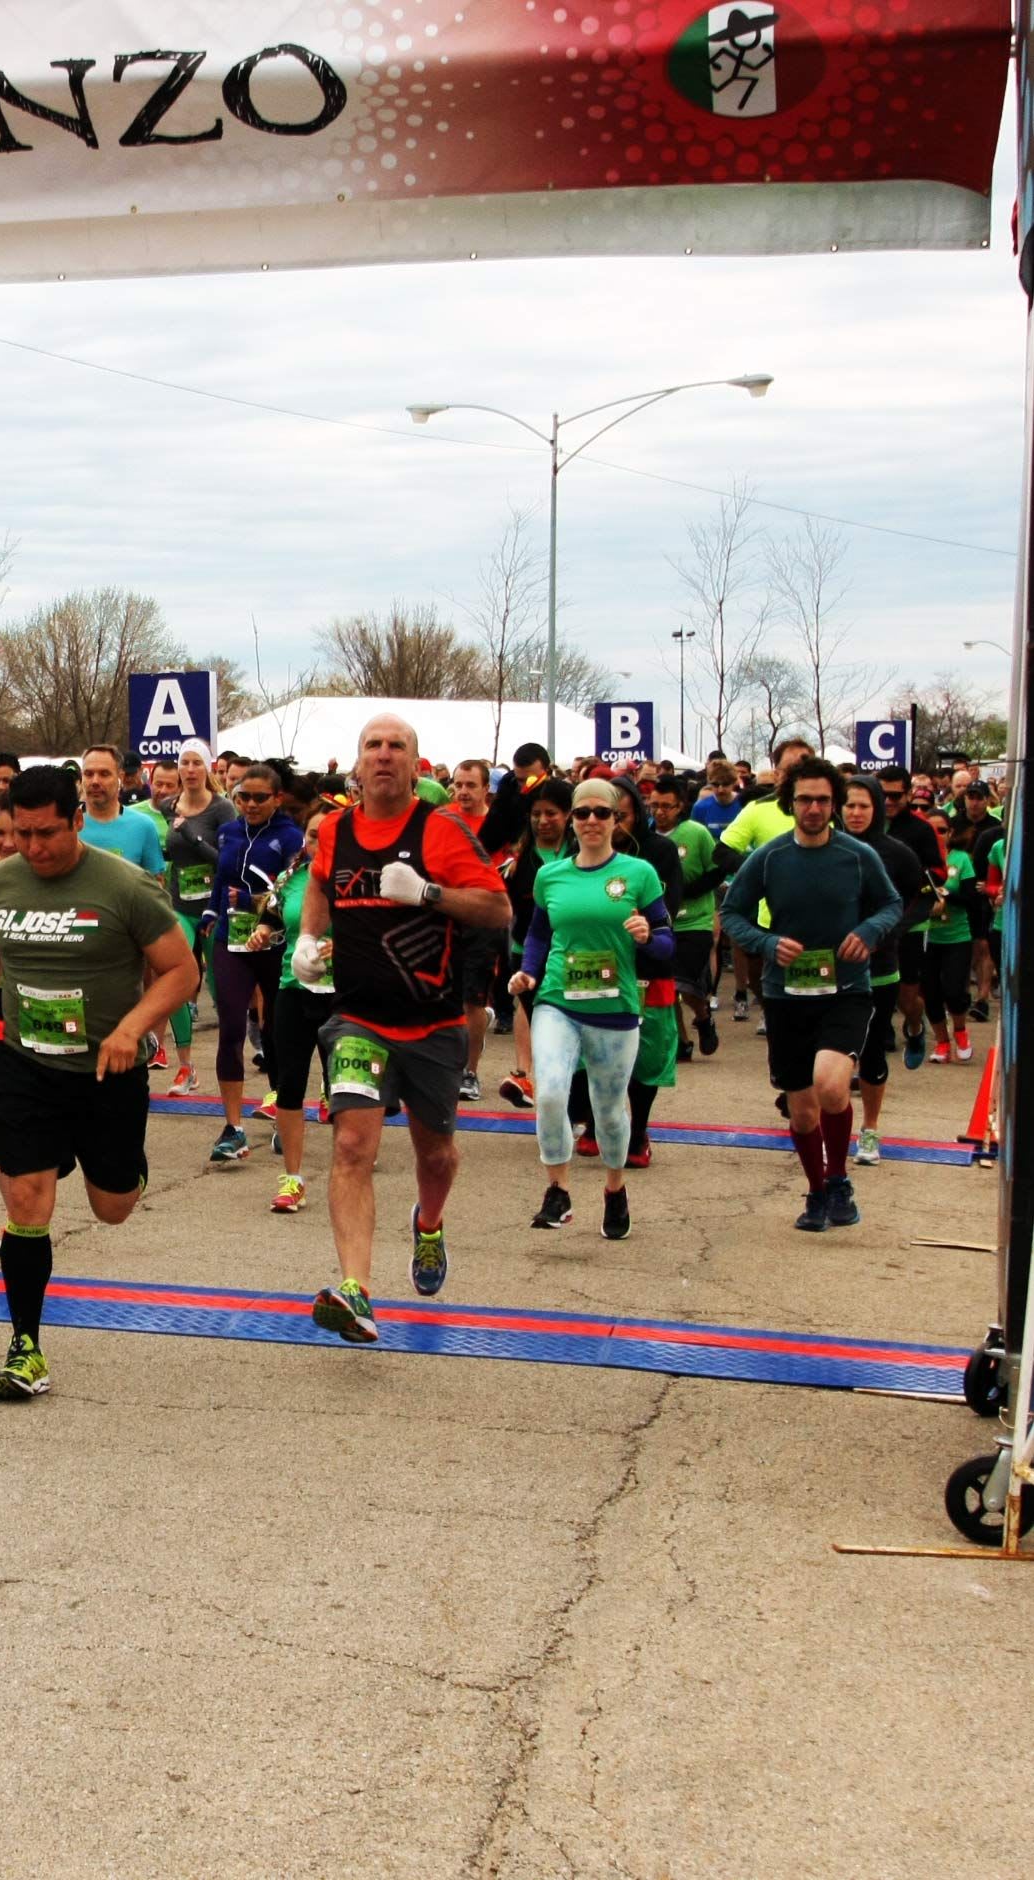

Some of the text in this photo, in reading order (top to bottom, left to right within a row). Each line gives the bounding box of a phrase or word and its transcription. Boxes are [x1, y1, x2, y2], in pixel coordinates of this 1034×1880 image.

[143, 679, 197, 737] A
[611, 707, 641, 749] B
[869, 723, 895, 760] C
[139, 740, 182, 755] CORR
[9, 932, 27, 940] REAL
[27, 934, 63, 942] MEXICAN
[62, 934, 85, 942] HERO
